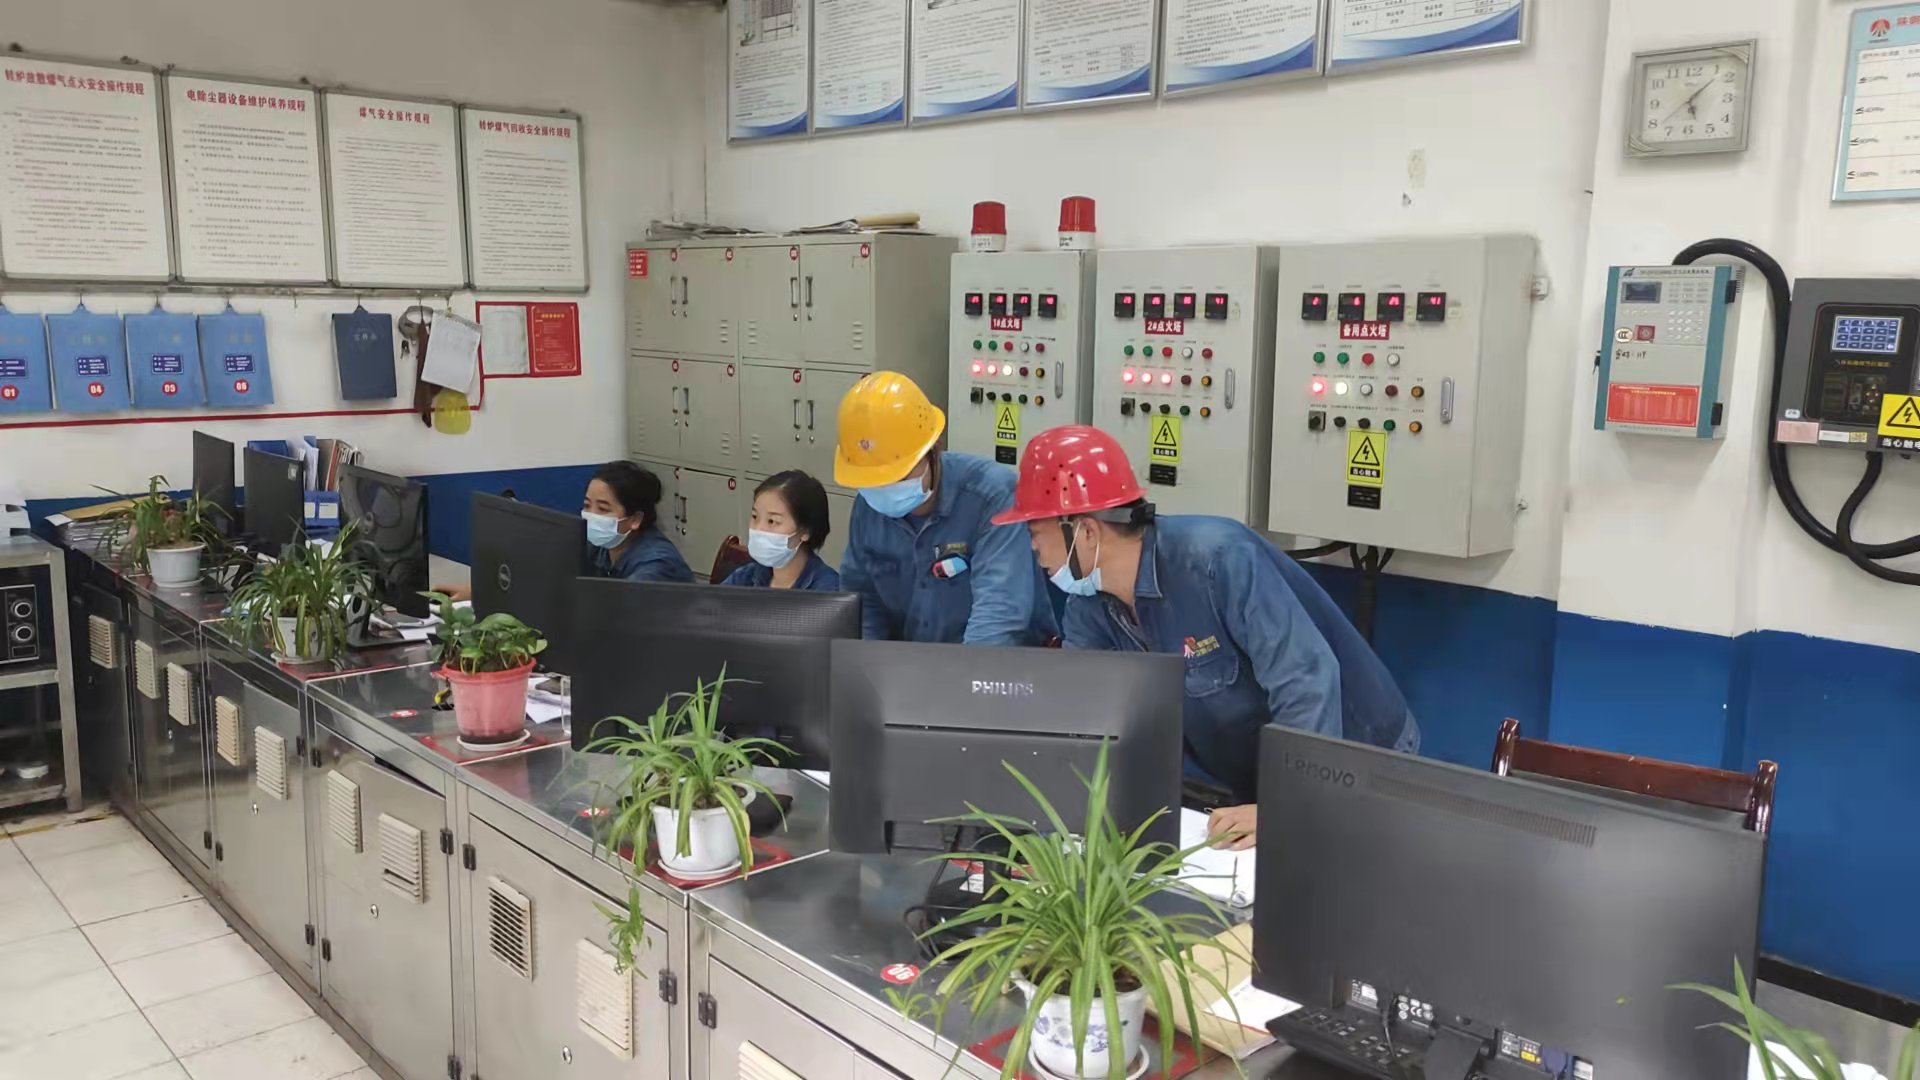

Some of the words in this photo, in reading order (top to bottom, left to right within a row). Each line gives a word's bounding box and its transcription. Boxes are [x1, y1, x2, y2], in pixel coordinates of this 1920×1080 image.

[1667, 68, 1679, 79] 11
[1685, 67, 1702, 77] 12
[1714, 64, 1719, 75] 1
[1724, 72, 1735, 83] 2
[1652, 79, 1664, 90] 10
[187, 89, 305, 111] 电除尘器设备维护保养规程
[1722, 93, 1733, 103] 3
[1650, 100, 1660, 109] 9
[359, 106, 430, 124] 煤气安全操作规程
[1720, 113, 1730, 123] 4
[479, 119, 571, 138] 转炉煤气回收安全操作规程
[1648, 119, 1658, 129] 8
[1705, 123, 1715, 134] 5
[1665, 126, 1673, 137] 7
[1683, 125, 1693, 135] 6
[993, 318, 1021, 329] 1#点火塔
[1147, 320, 1182, 333] 2#点火塔
[1343, 324, 1387, 337] 备用点火塔
[4, 388, 16, 397] 01
[90, 385, 103, 394] 04
[971, 680, 1033, 696] PHILIPS
[1284, 752, 1355, 788] Lenovo
